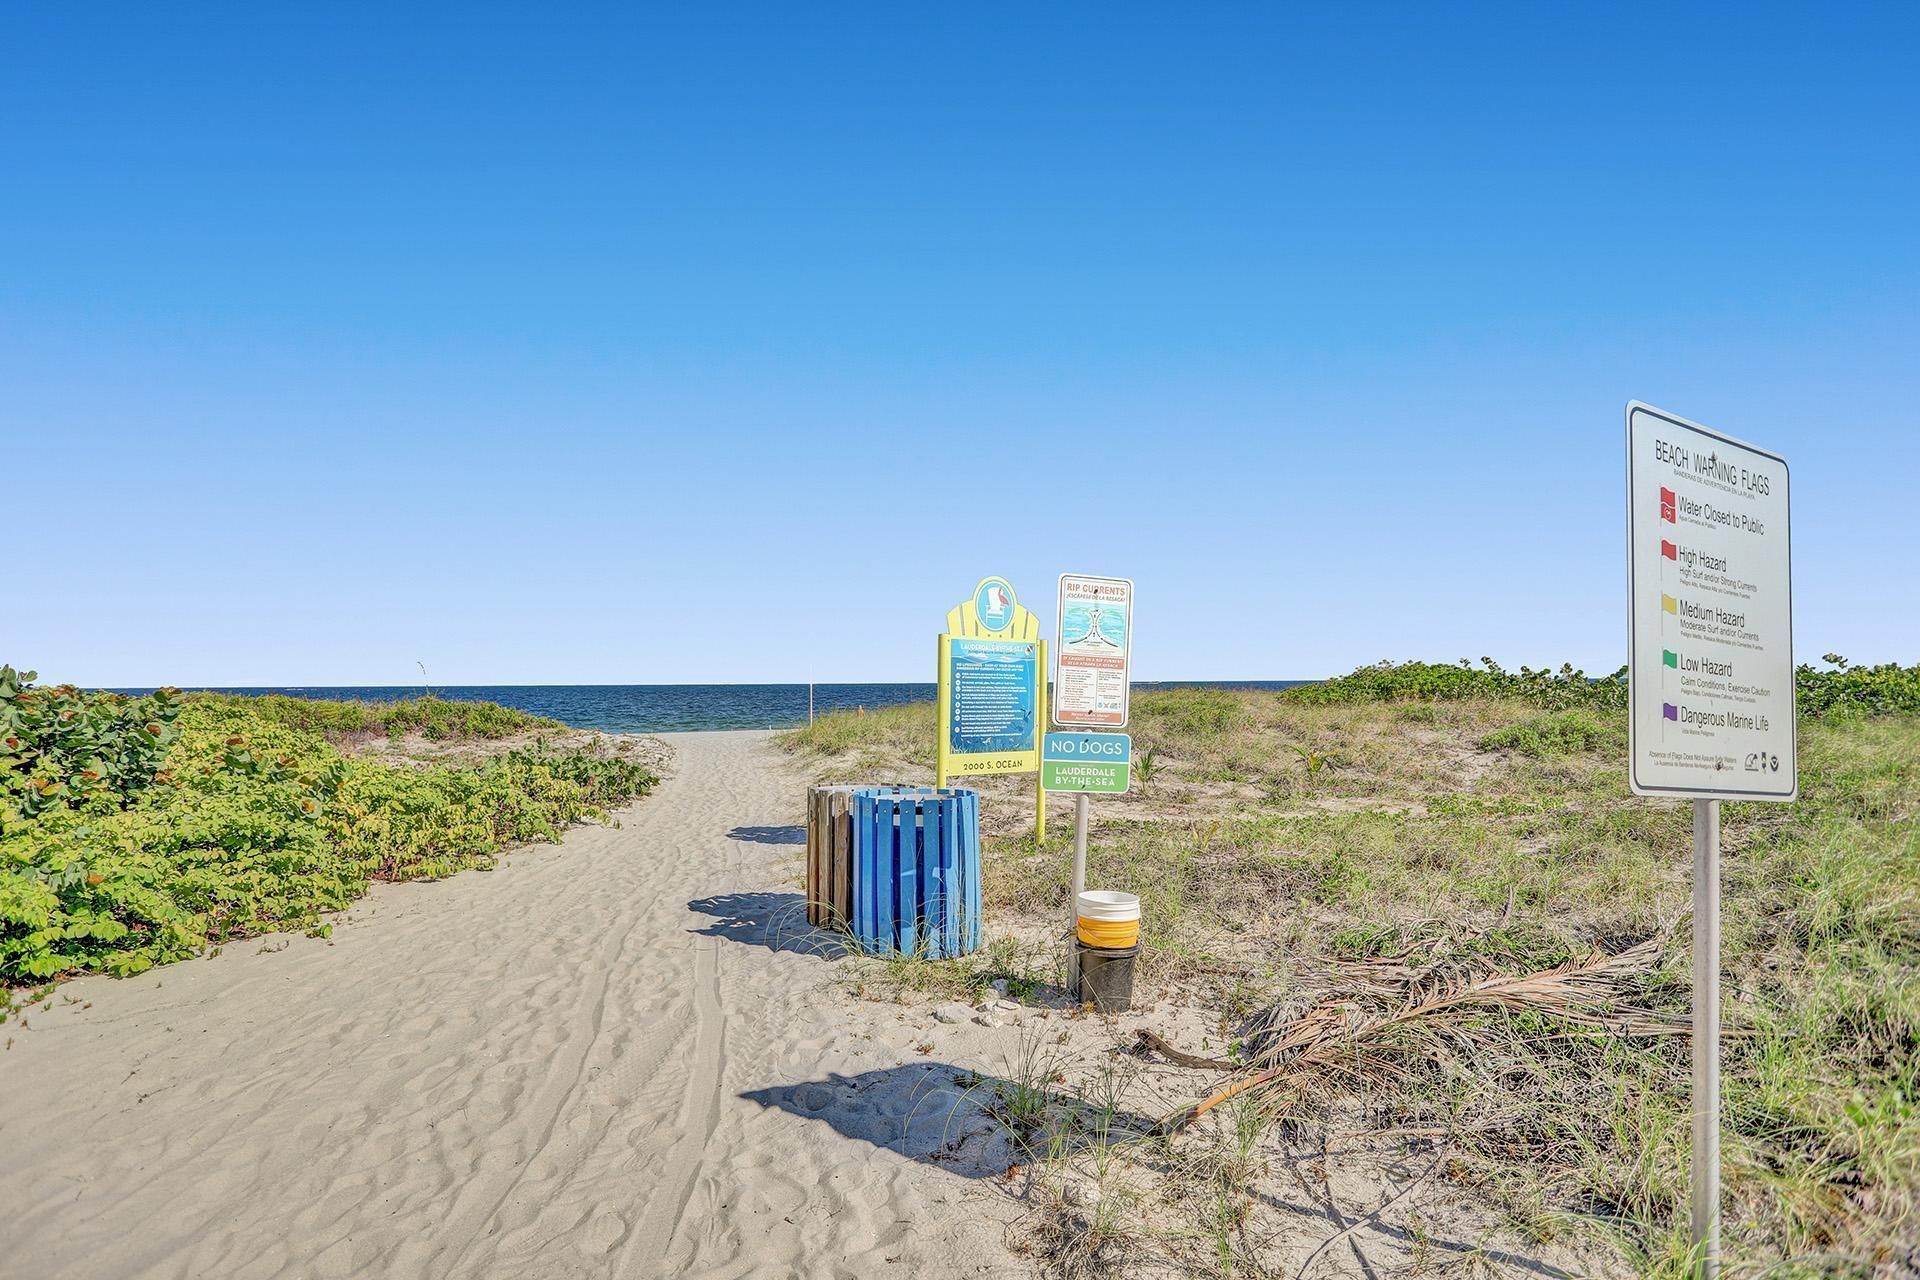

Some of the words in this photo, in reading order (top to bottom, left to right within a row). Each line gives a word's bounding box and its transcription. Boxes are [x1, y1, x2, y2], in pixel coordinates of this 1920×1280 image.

[1656, 440, 1688, 469] BEACH
[1693, 452, 1737, 485] WARNING
[1742, 469, 1770, 496] FLAGS
[1679, 495, 1702, 517] Water
[1704, 504, 1731, 526] Closed
[1733, 514, 1740, 528] to
[1742, 515, 1764, 535] Public
[1680, 545, 1697, 568] High
[1700, 550, 1726, 572] Hazard
[1067, 583, 1080, 591] RIP
[1083, 584, 1125, 596] CURRENTS
[1680, 567, 1691, 578] High
[1693, 569, 1703, 579] Surf
[1720, 576, 1736, 590] Strong
[1680, 600, 1713, 621] Medium
[1716, 607, 1744, 628] Hazard
[1680, 619, 1706, 632] Moderate
[1708, 624, 1718, 634] Surf
[1737, 630, 1759, 641] Currents
[1680, 654, 1699, 672] Low
[1702, 657, 1732, 677] Hazard
[1680, 676, 1696, 686] Calm
[1728, 682, 1750, 694] Exercise
[1750, 686, 1770, 696] Caution
[1681, 706, 1725, 728] Dangerous
[1727, 712, 1753, 730] Marine
[1755, 715, 1769, 731] Life
[1052, 740, 1075, 753] NO
[1080, 741, 1122, 755] DOGS
[987, 760, 993, 769] S.
[996, 760, 1022, 768] OCEAN
[1055, 767, 1115, 776] LAUDERDALE
